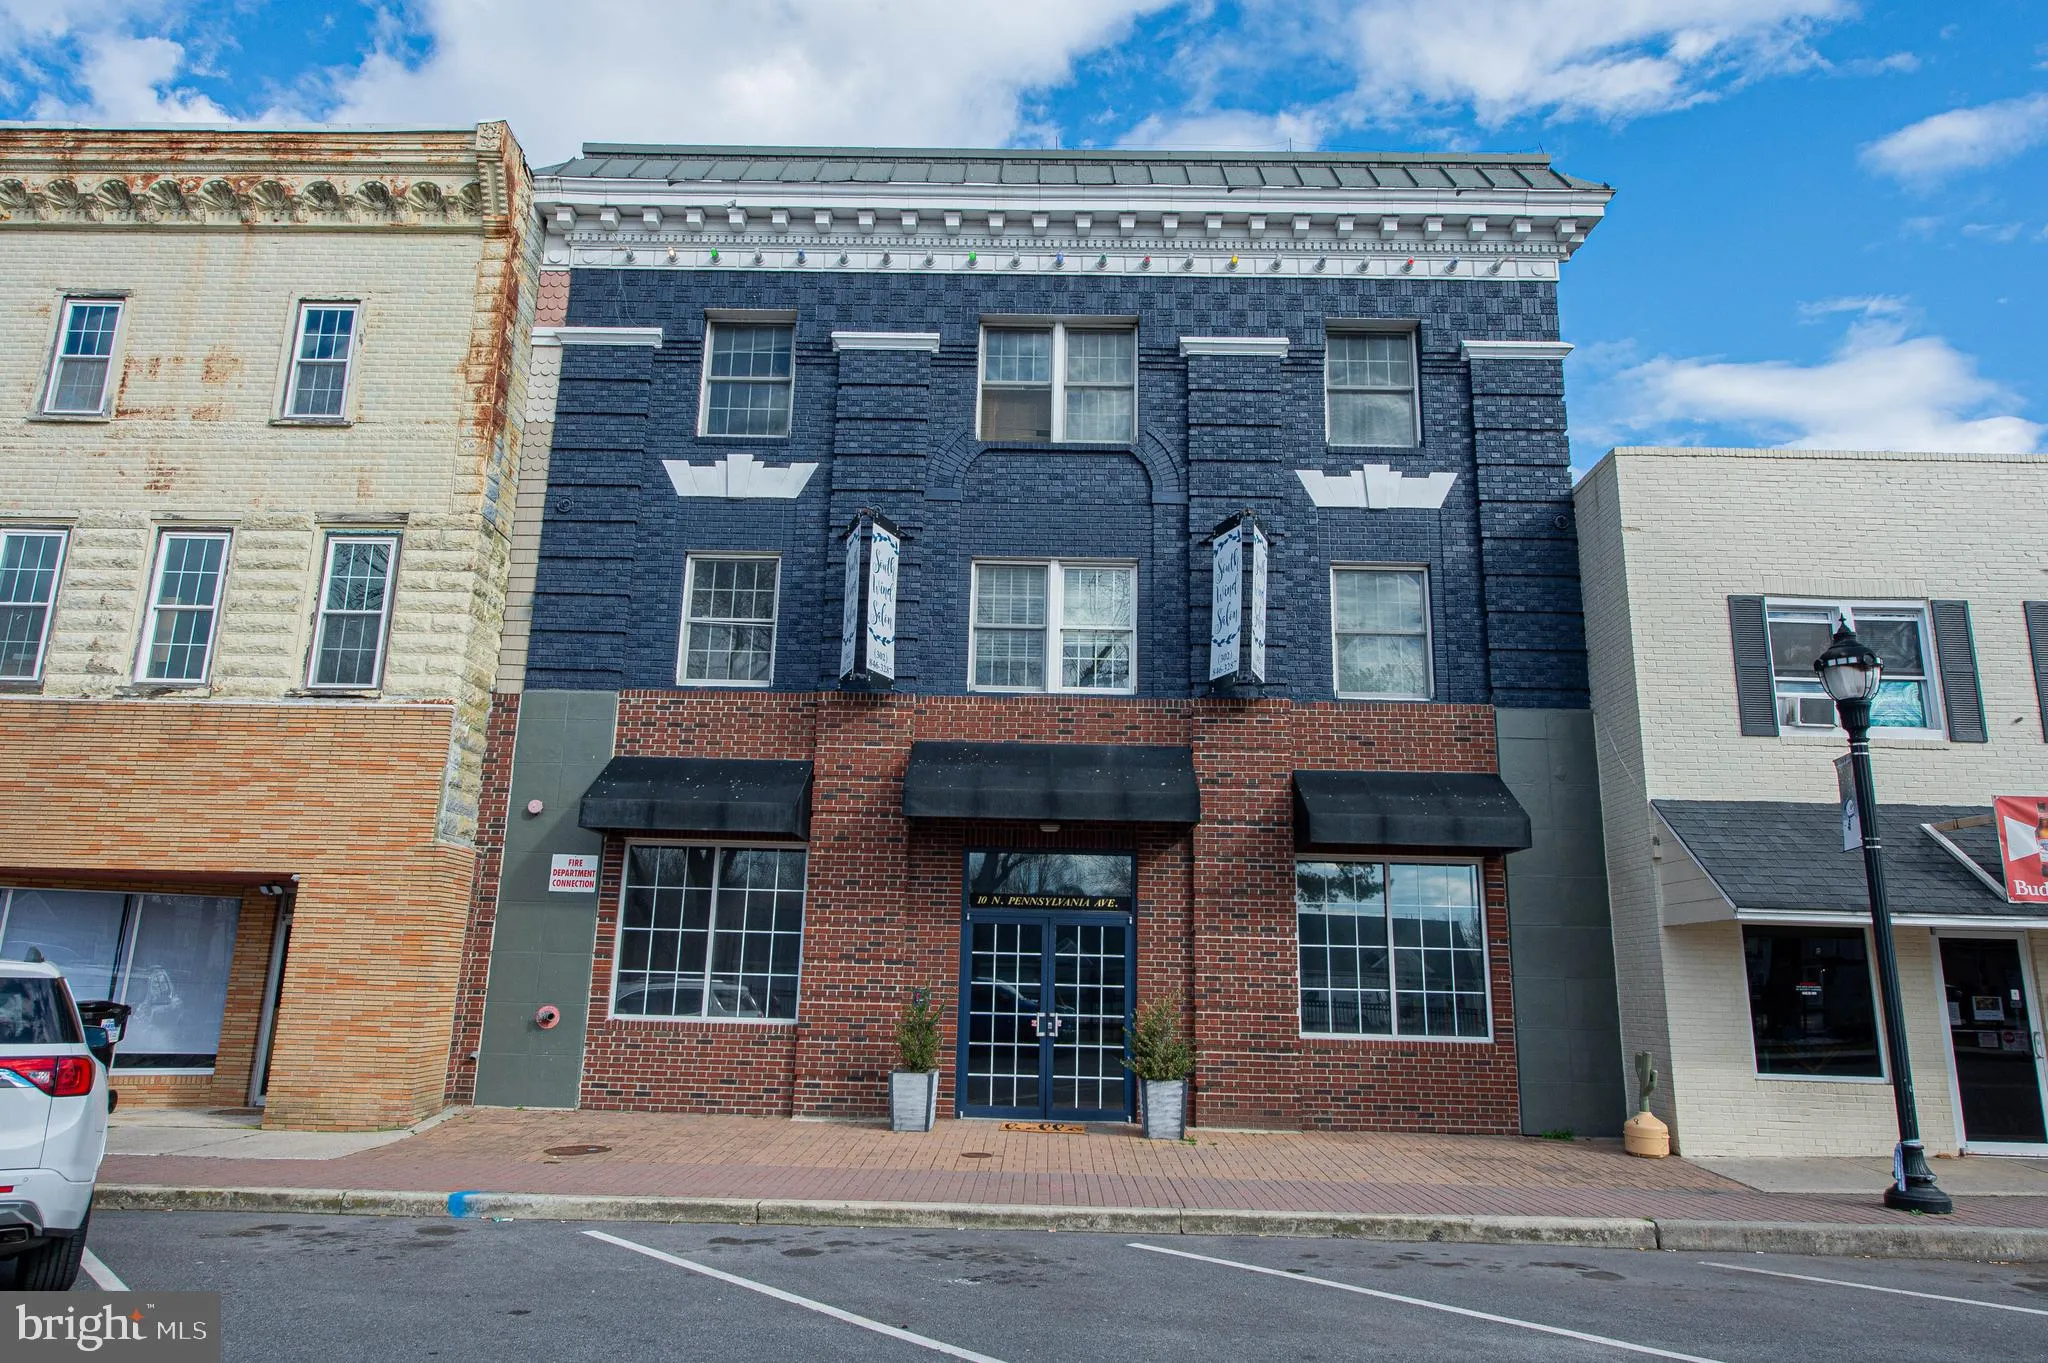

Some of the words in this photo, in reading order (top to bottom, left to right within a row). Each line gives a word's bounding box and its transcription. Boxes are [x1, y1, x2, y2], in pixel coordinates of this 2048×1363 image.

[872, 548, 896, 581] South
[1215, 548, 1239, 584] South
[872, 574, 894, 602] Wind
[1216, 573, 1239, 604] Wind
[871, 600, 893, 630] Salon
[1214, 601, 1238, 634] Salon
[873, 649, 888, 664] (302)
[1217, 650, 1233, 666] (302)
[568, 858, 583, 867] FIRE
[552, 869, 596, 878] DEPARTMENT
[552, 879, 595, 888] CONNECTION
[2013, 880, 2048, 897] Bud
[977, 895, 987, 904] 10
[991, 896, 1004, 905] N.
[1007, 896, 1090, 908] PENNSYLVANIA
[1094, 898, 1119, 908] AVE.
